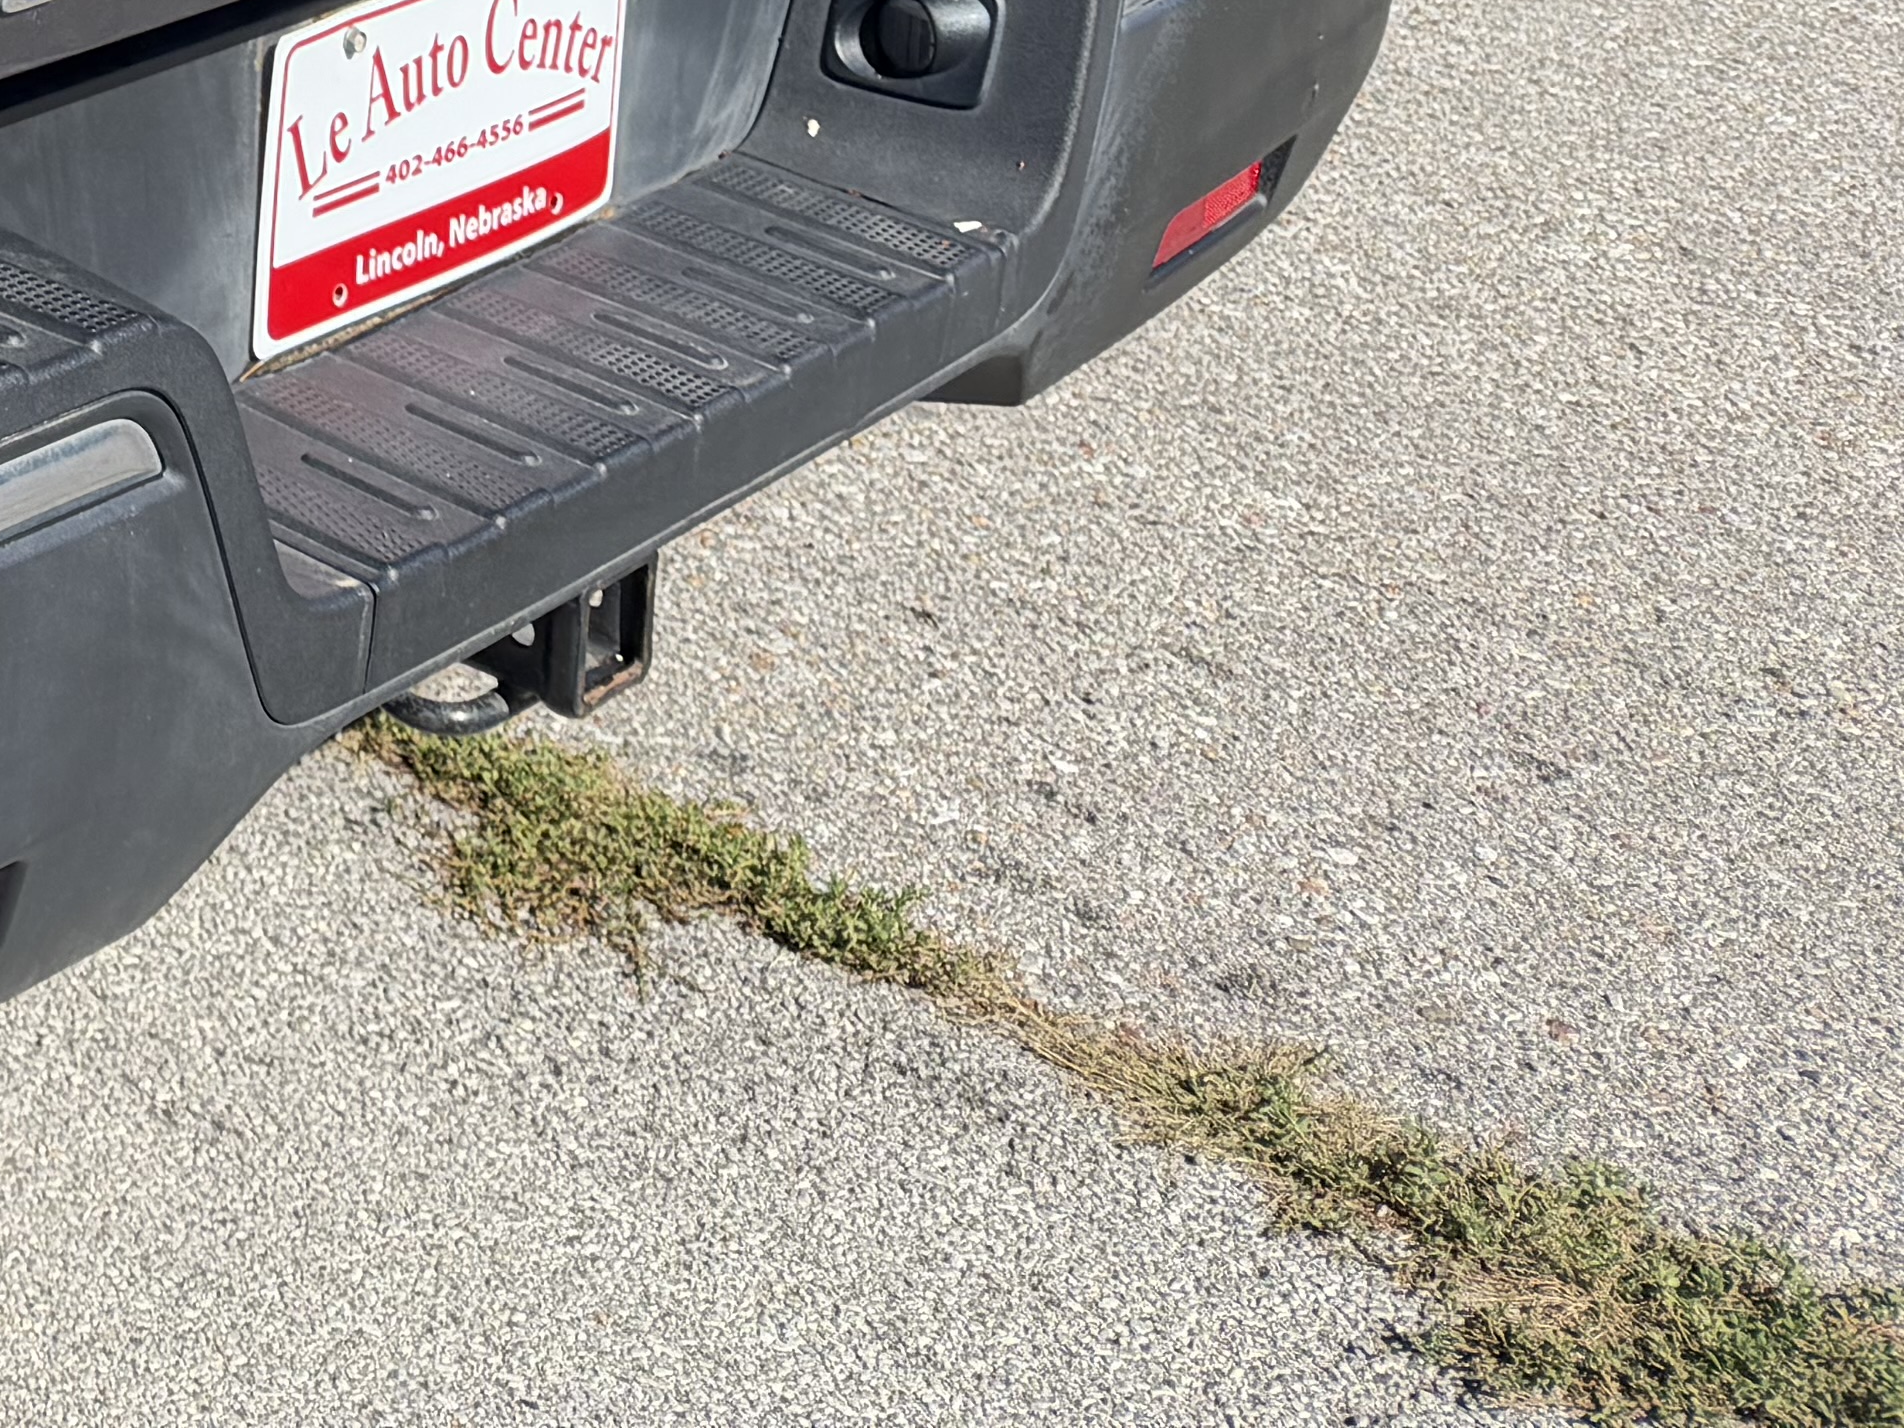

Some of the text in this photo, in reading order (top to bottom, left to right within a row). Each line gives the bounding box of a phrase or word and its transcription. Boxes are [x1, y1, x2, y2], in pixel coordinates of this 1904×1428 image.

[285, 105, 353, 201] Le
[361, 32, 471, 143] Auto
[384, 112, 525, 186] 402-466-4556
[355, 182, 548, 286] Lincoln, Nebraska
